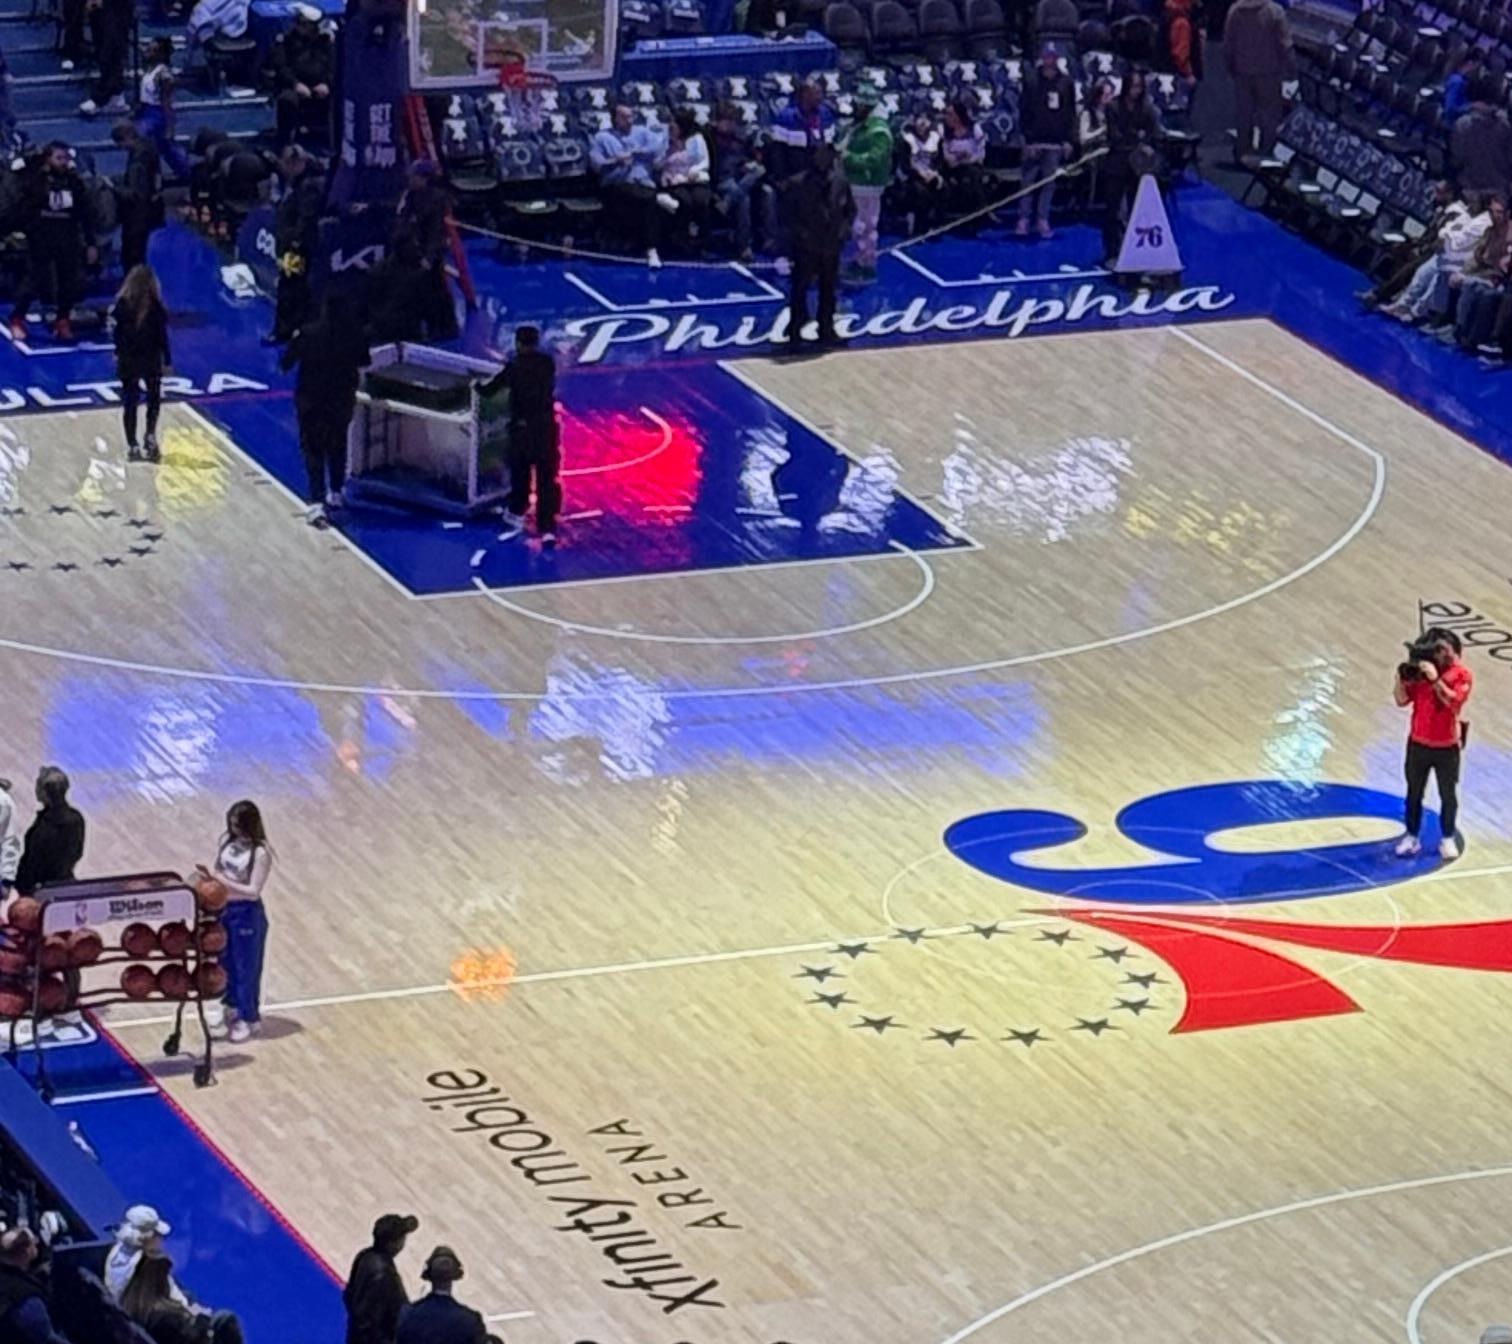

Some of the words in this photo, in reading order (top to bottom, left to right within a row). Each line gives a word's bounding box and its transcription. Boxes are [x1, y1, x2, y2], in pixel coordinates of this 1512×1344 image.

[1135, 225, 1162, 247] 76
[422, 1067, 592, 1187] mobile
[587, 1118, 743, 1231] ARENA
